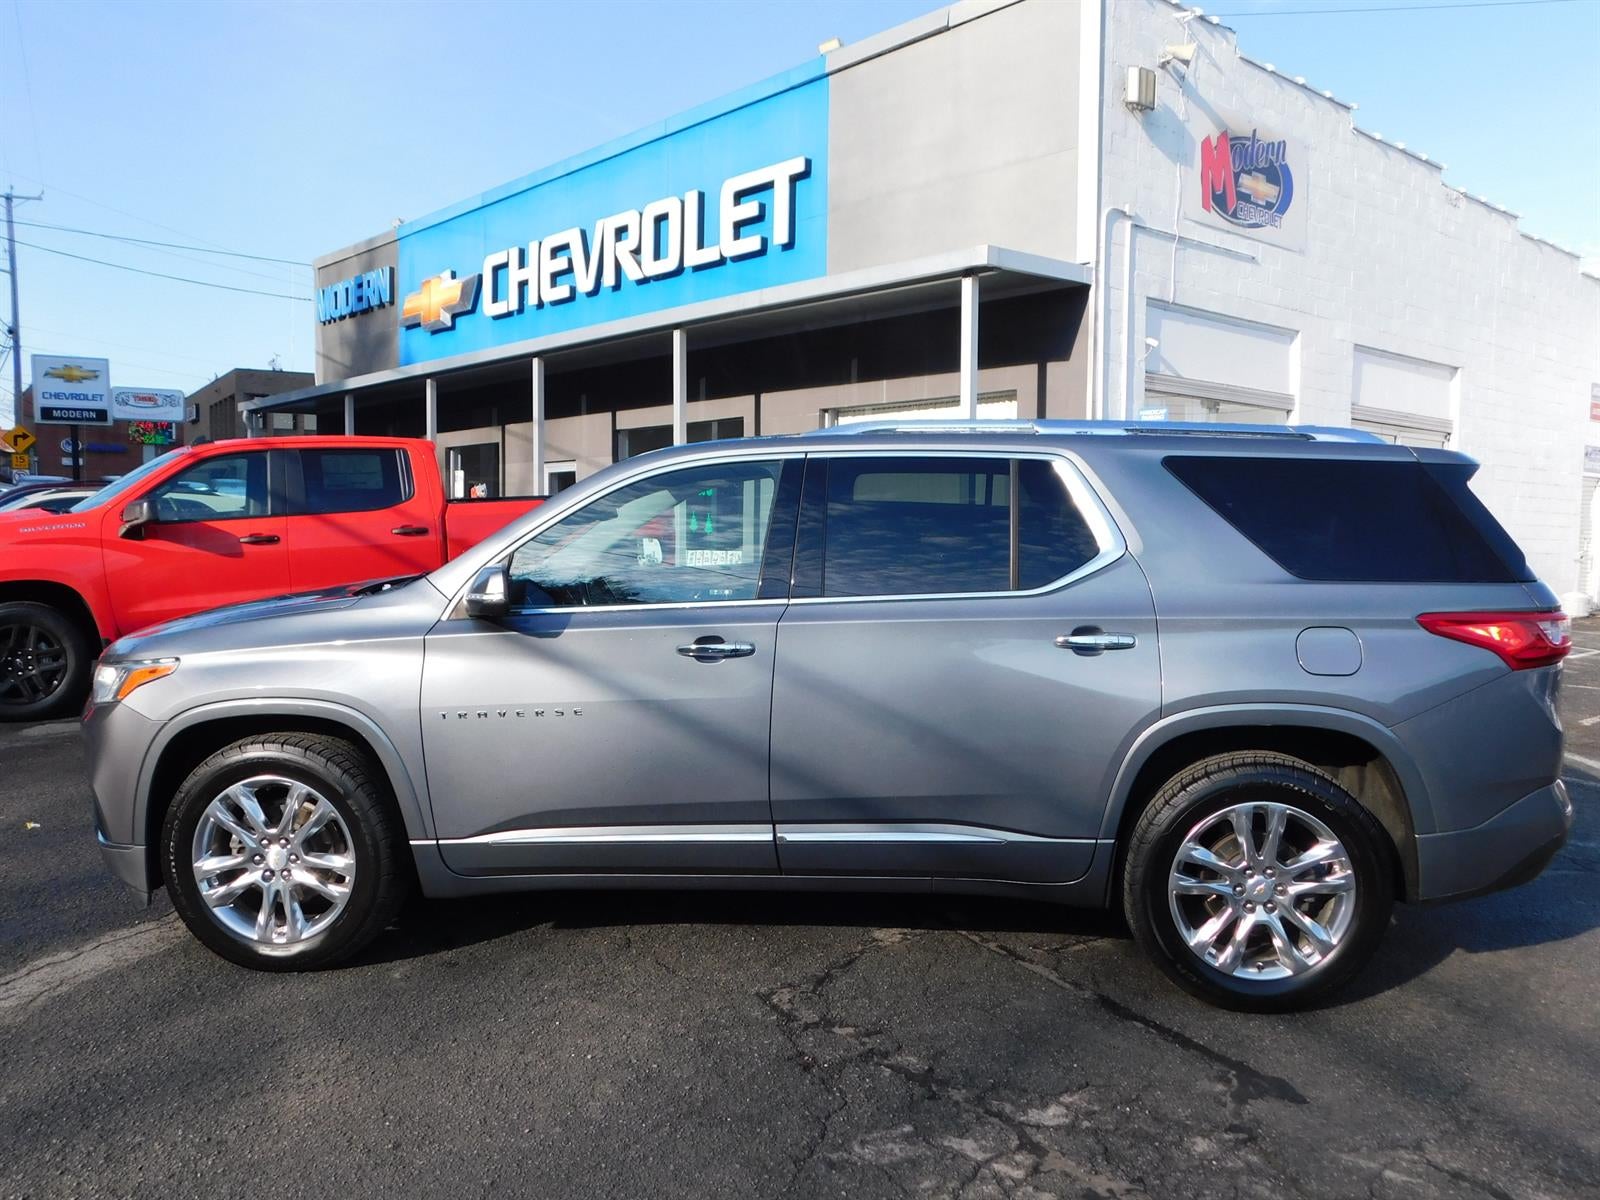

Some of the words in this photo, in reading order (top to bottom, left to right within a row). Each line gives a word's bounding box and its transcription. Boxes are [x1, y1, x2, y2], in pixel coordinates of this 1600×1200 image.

[1200, 128, 1287, 215] Modern
[1236, 201, 1283, 229] CHEVROLET
[481, 156, 811, 319] CHEVROLET
[317, 265, 395, 325] MODERN
[41, 391, 105, 402] CHEVROLET
[52, 409, 97, 419] MODERN
[15, 455, 26, 464] 15
[438, 707, 584, 720] TRAVERSE
